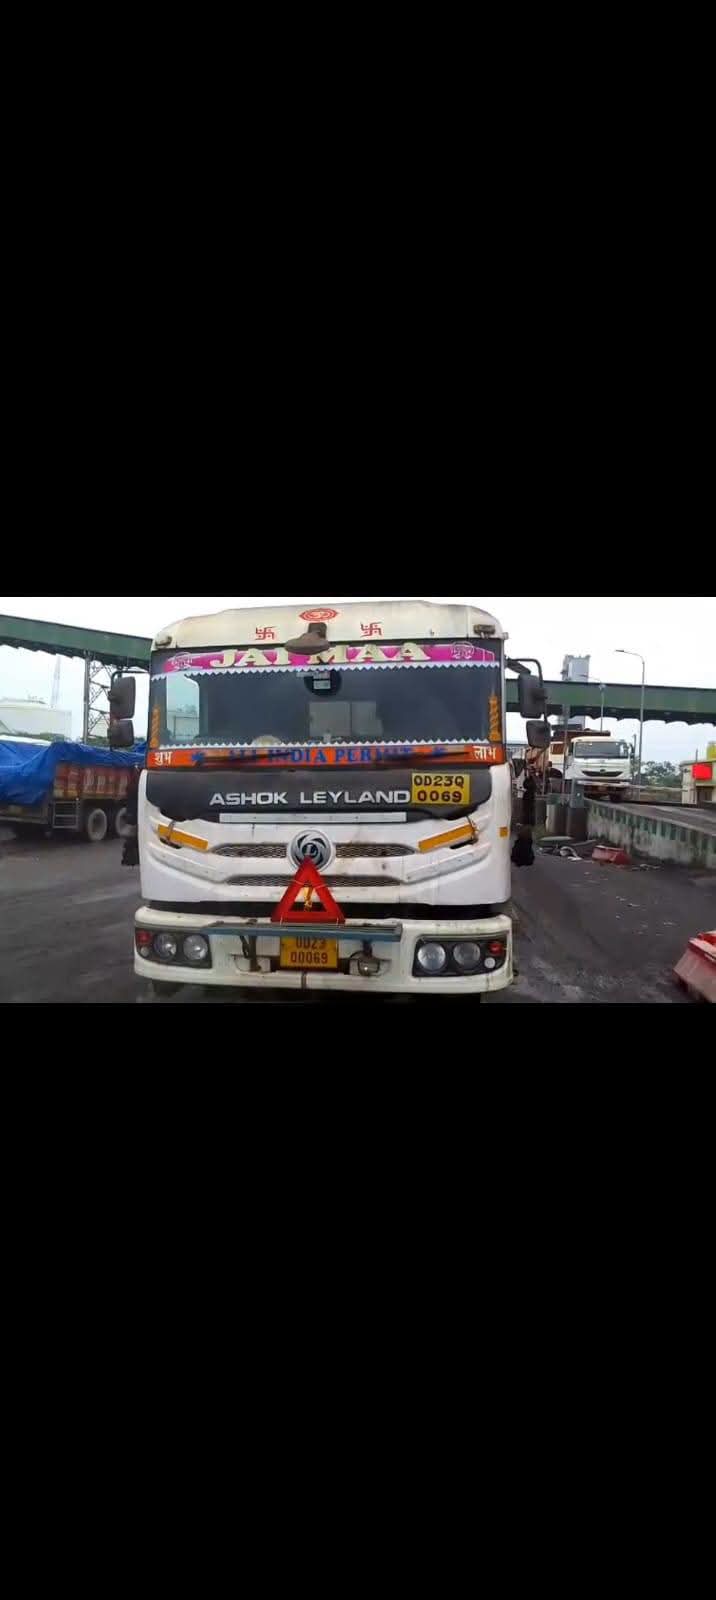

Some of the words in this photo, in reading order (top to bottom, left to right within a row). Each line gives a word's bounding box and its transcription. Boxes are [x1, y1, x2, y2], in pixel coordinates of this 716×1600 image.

[210, 648, 291, 668] JAI
[308, 643, 431, 664] MAA
[154, 752, 173, 766] शुभ
[473, 745, 497, 760] लाभ
[414, 775, 465, 788] OD23Q
[210, 792, 289, 806] ASHOK
[300, 790, 411, 804] LEYLAND
[417, 790, 463, 803] 0069
